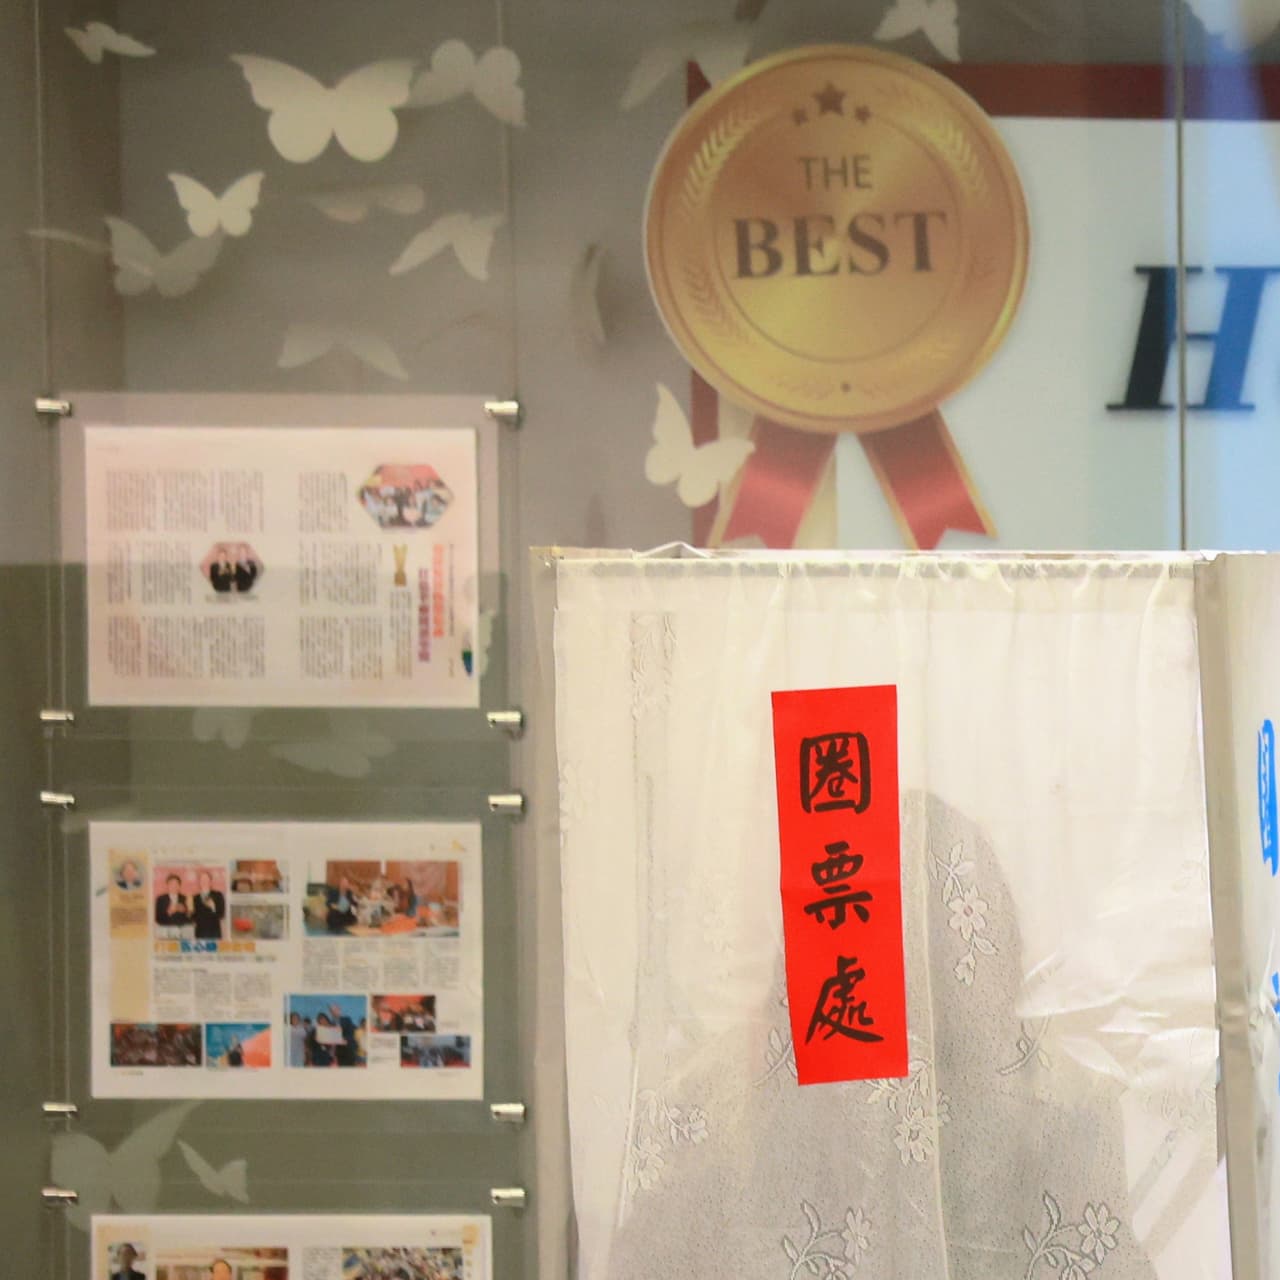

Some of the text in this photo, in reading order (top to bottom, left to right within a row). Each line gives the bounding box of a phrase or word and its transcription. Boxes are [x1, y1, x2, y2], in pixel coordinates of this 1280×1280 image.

[797, 153, 873, 191] THE
[732, 210, 948, 279] BEST
[799, 730, 884, 1045] 圈票處
